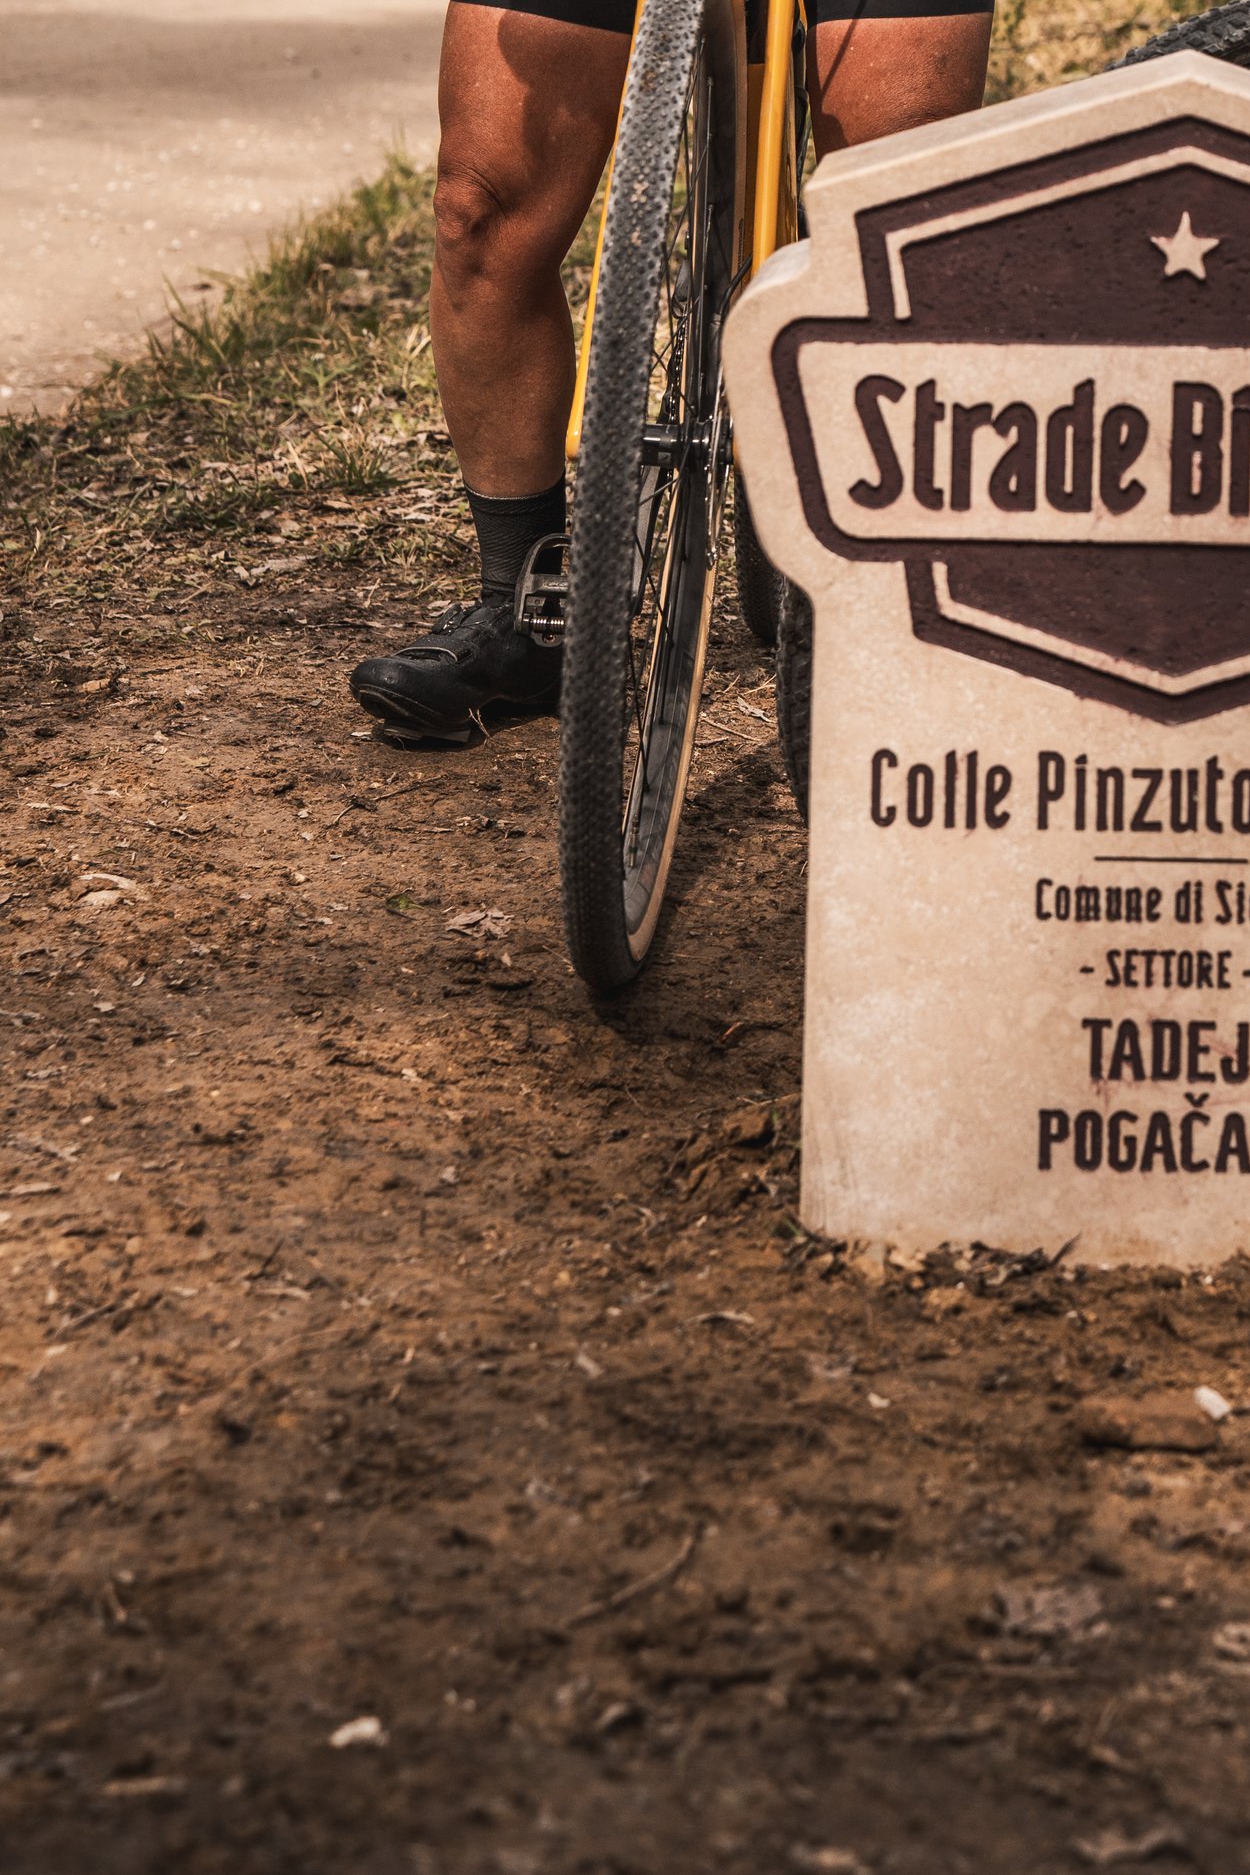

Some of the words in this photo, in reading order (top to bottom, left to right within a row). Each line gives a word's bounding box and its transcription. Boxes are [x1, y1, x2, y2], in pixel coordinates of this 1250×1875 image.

[848, 374, 1150, 516] Strade
[870, 747, 1013, 830] Colle
[1035, 878, 1162, 924] Comune
[1175, 880, 1206, 925] di
[1104, 948, 1233, 990] SETTORE
[1081, 1017, 1250, 1085] TADEJ
